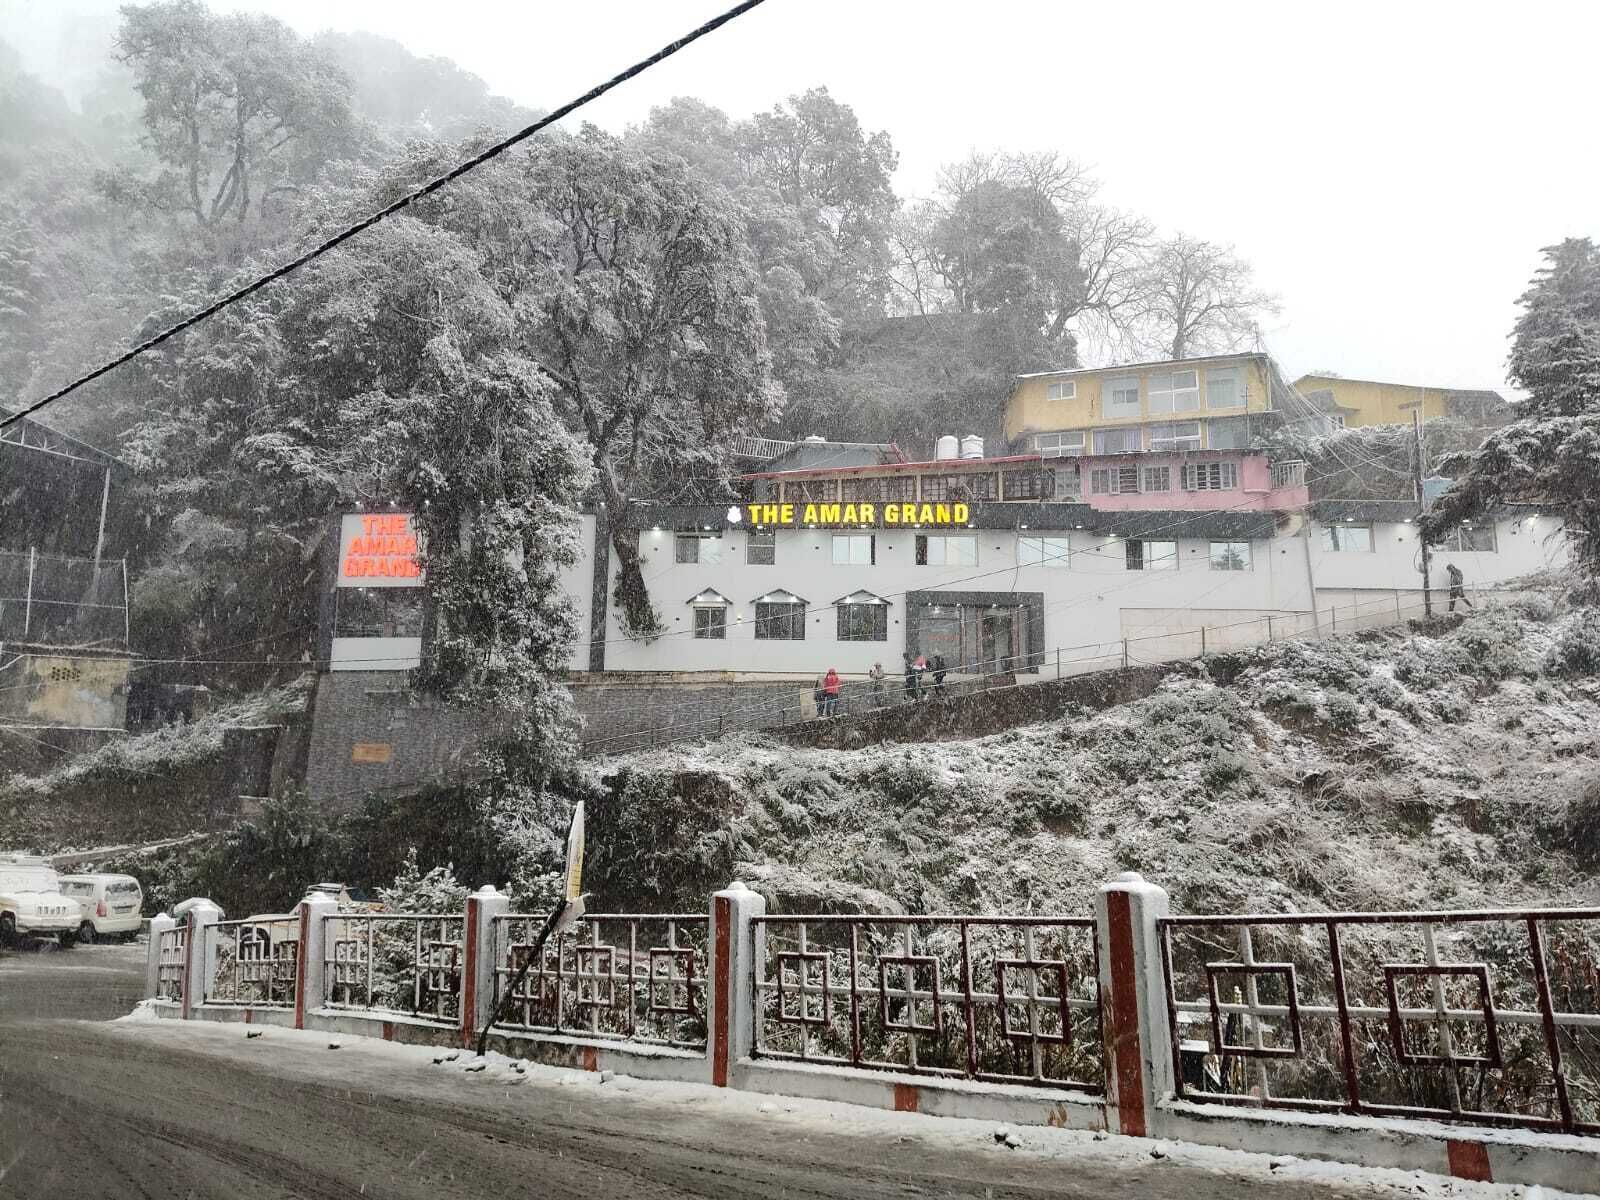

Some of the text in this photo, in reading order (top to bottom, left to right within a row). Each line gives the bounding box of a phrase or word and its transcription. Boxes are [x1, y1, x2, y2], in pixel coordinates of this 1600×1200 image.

[747, 503, 970, 524] THE AMAR GRAND
[361, 514, 408, 535] THE
